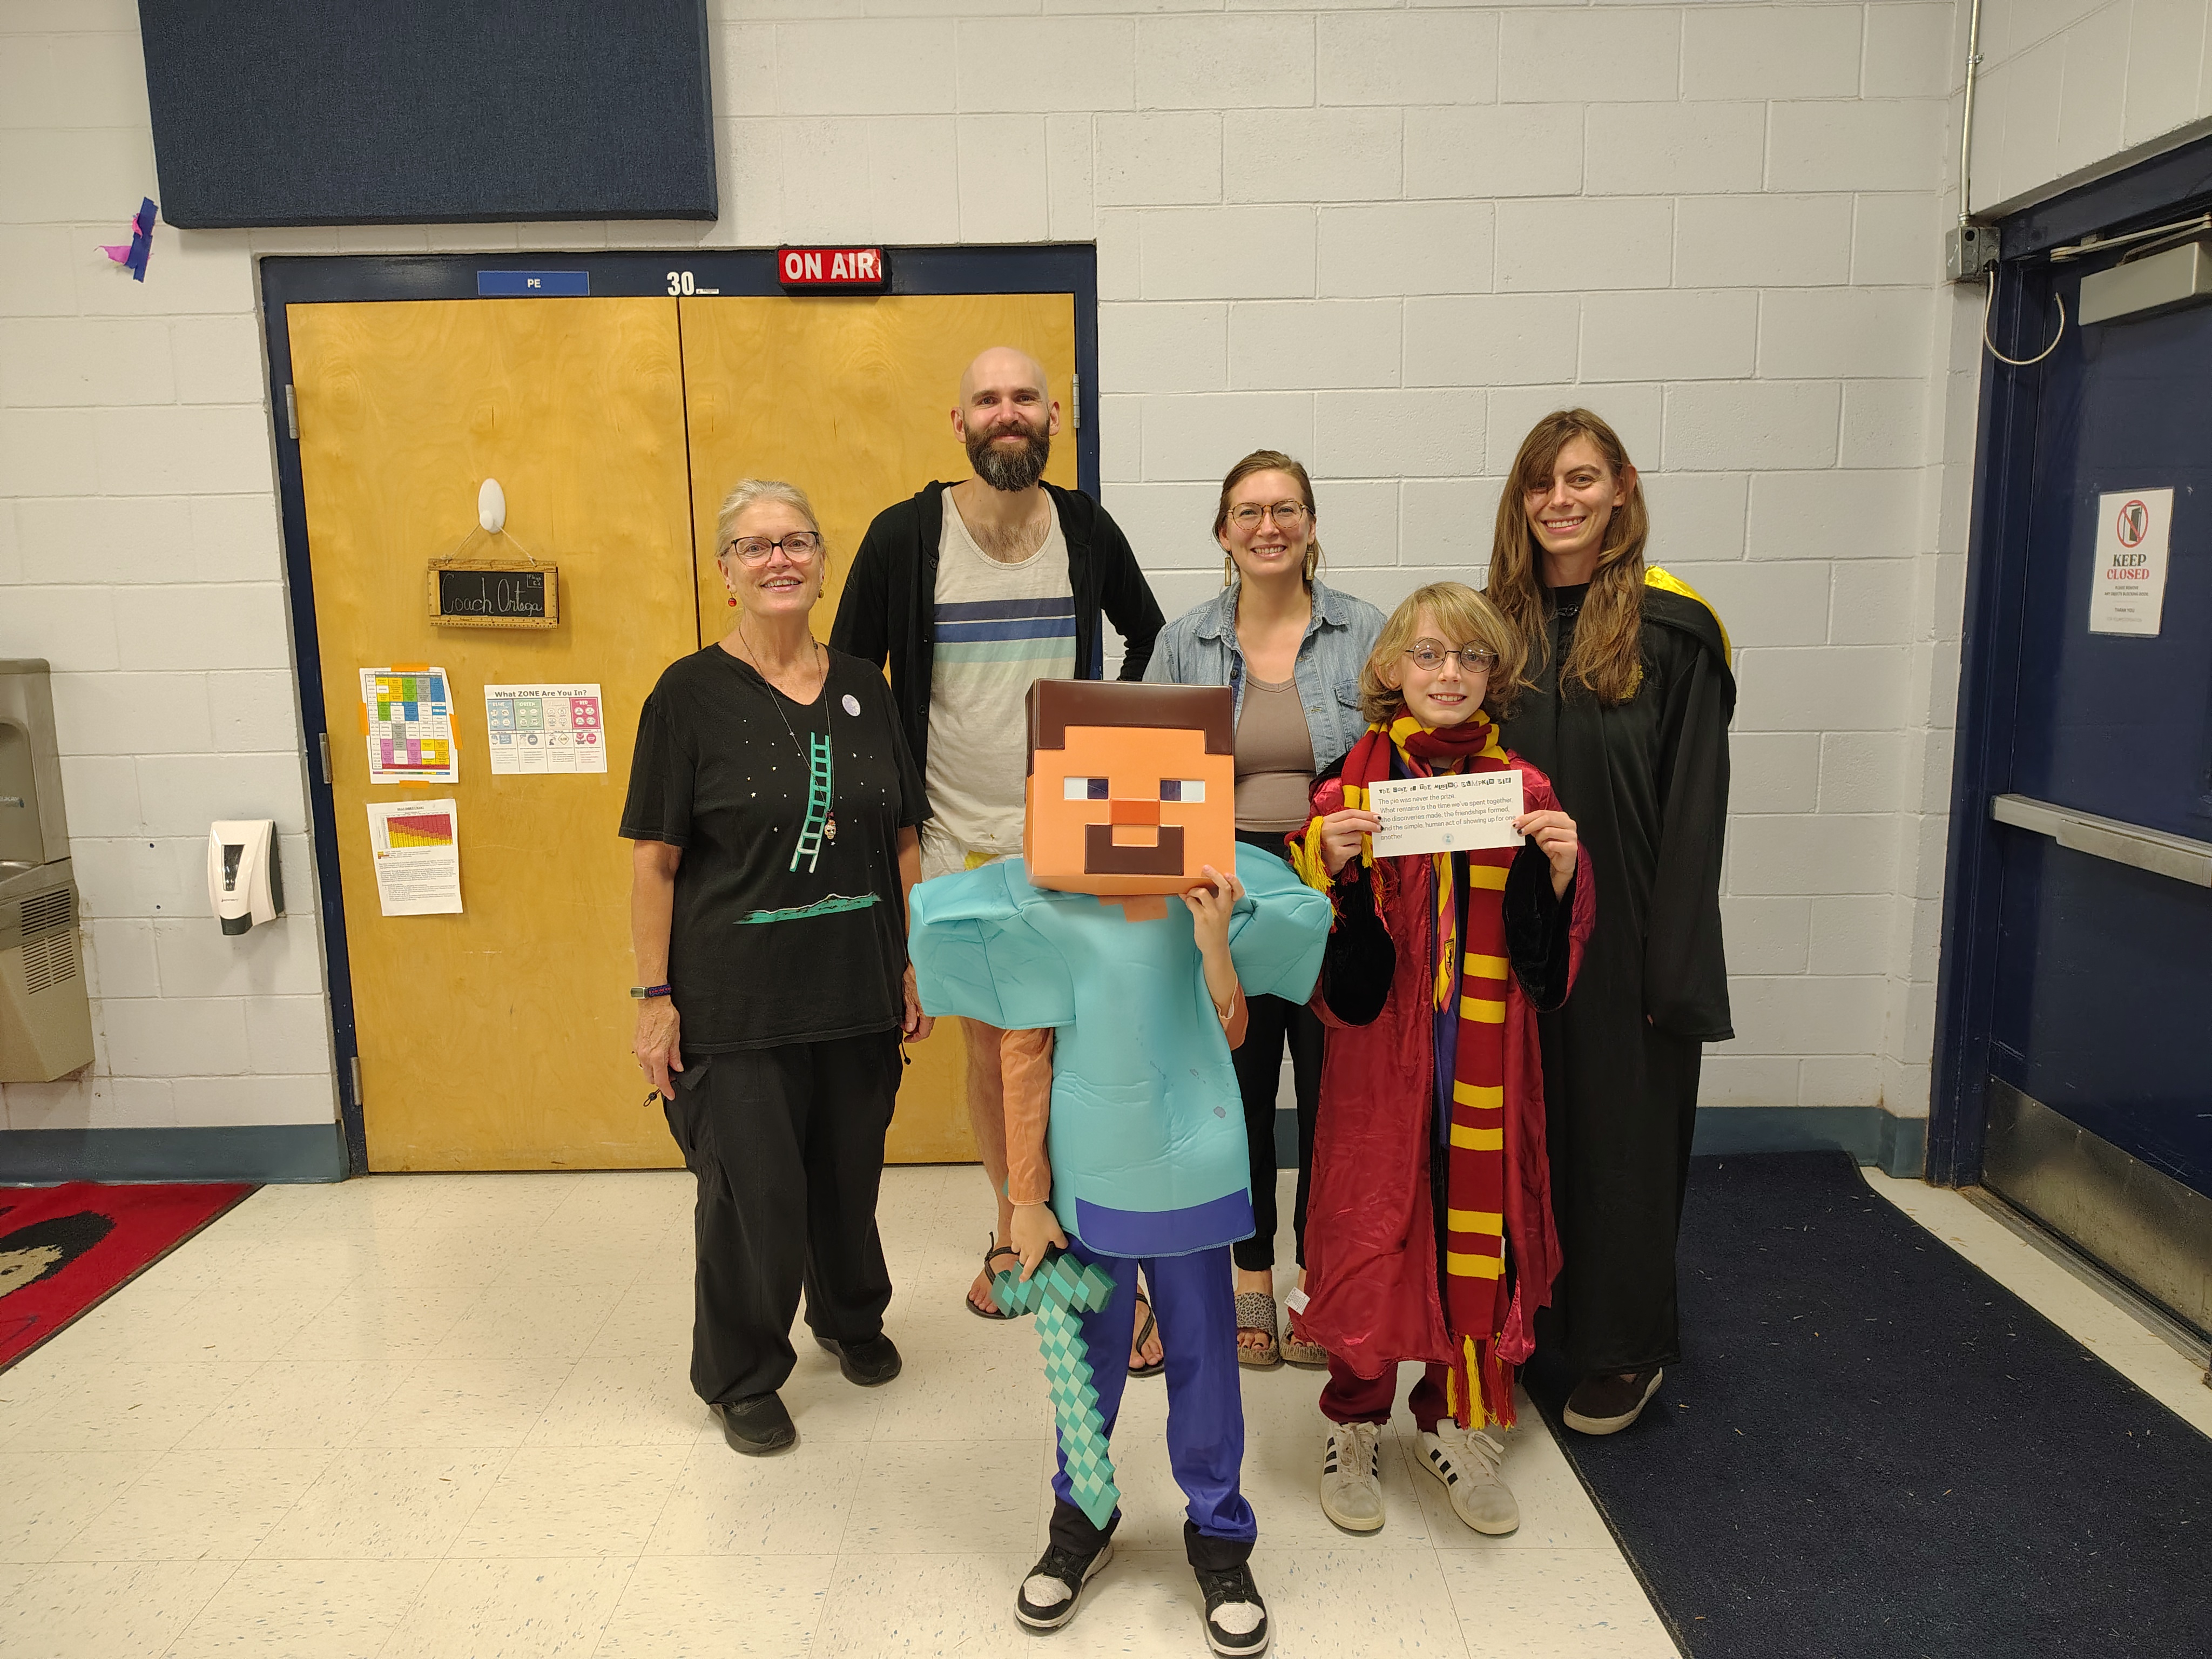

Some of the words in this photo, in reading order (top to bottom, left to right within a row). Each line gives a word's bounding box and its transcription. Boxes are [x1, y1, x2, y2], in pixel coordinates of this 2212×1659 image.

[785, 253, 822, 280] ON
[831, 252, 875, 279] AIR
[527, 279, 541, 288] PE
[666, 271, 694, 296] 30
[2112, 554, 2147, 567] KEEP
[2107, 569, 2150, 580] CLOSED
[442, 574, 495, 614] Coach
[497, 578, 542, 617] Ortega
[1455, 808, 1487, 817] friendships
